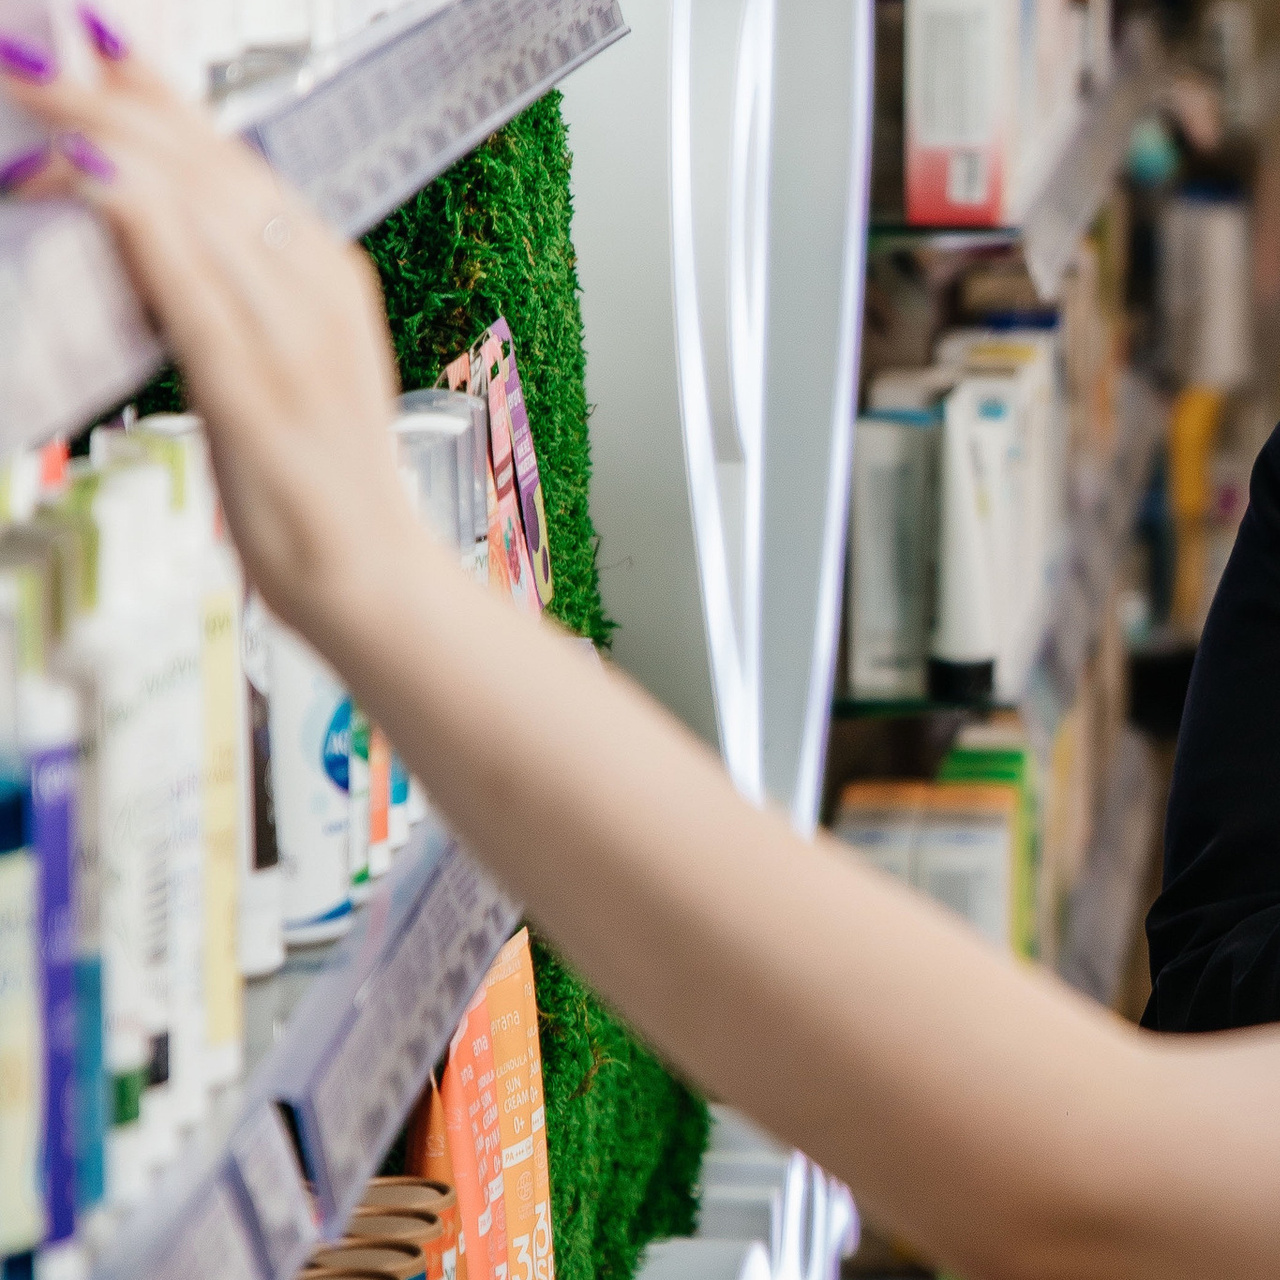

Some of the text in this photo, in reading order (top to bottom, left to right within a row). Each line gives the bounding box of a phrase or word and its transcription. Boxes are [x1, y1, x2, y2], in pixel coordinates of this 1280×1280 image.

[505, 1075, 522, 1095] SUN
[503, 1089, 530, 1114] CREAM
[513, 1116, 525, 1135] 0+
